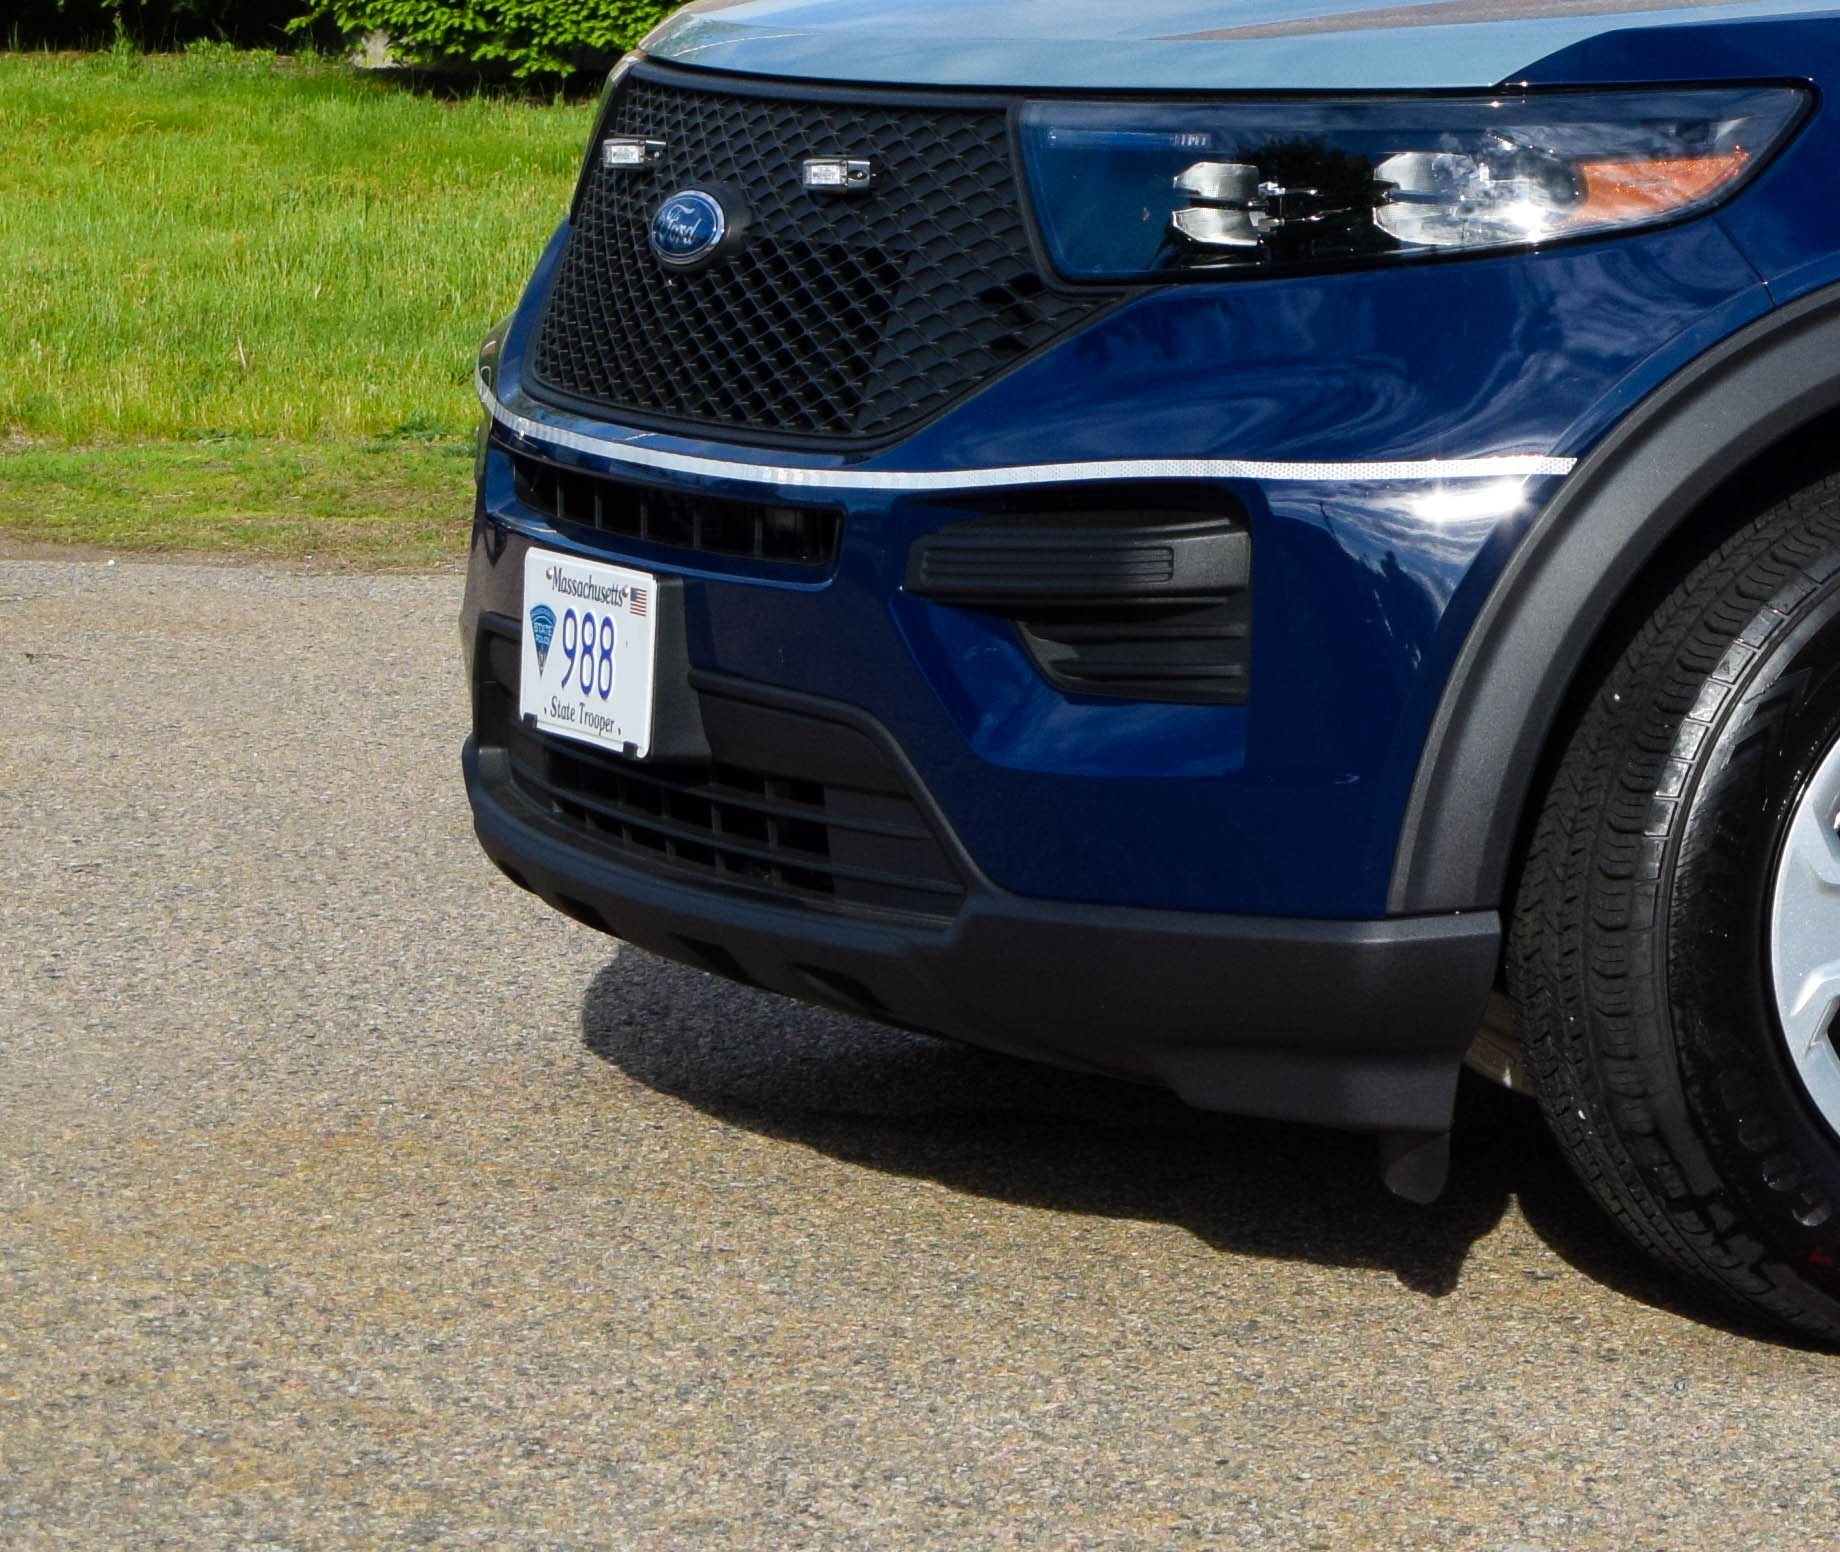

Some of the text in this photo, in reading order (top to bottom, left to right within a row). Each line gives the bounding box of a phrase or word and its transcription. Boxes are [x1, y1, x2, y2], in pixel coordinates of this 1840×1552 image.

[662, 204, 702, 245] Ford
[552, 565, 623, 607] Massachusetts
[561, 608, 615, 700] 988
[550, 696, 615, 736] State Trooper
